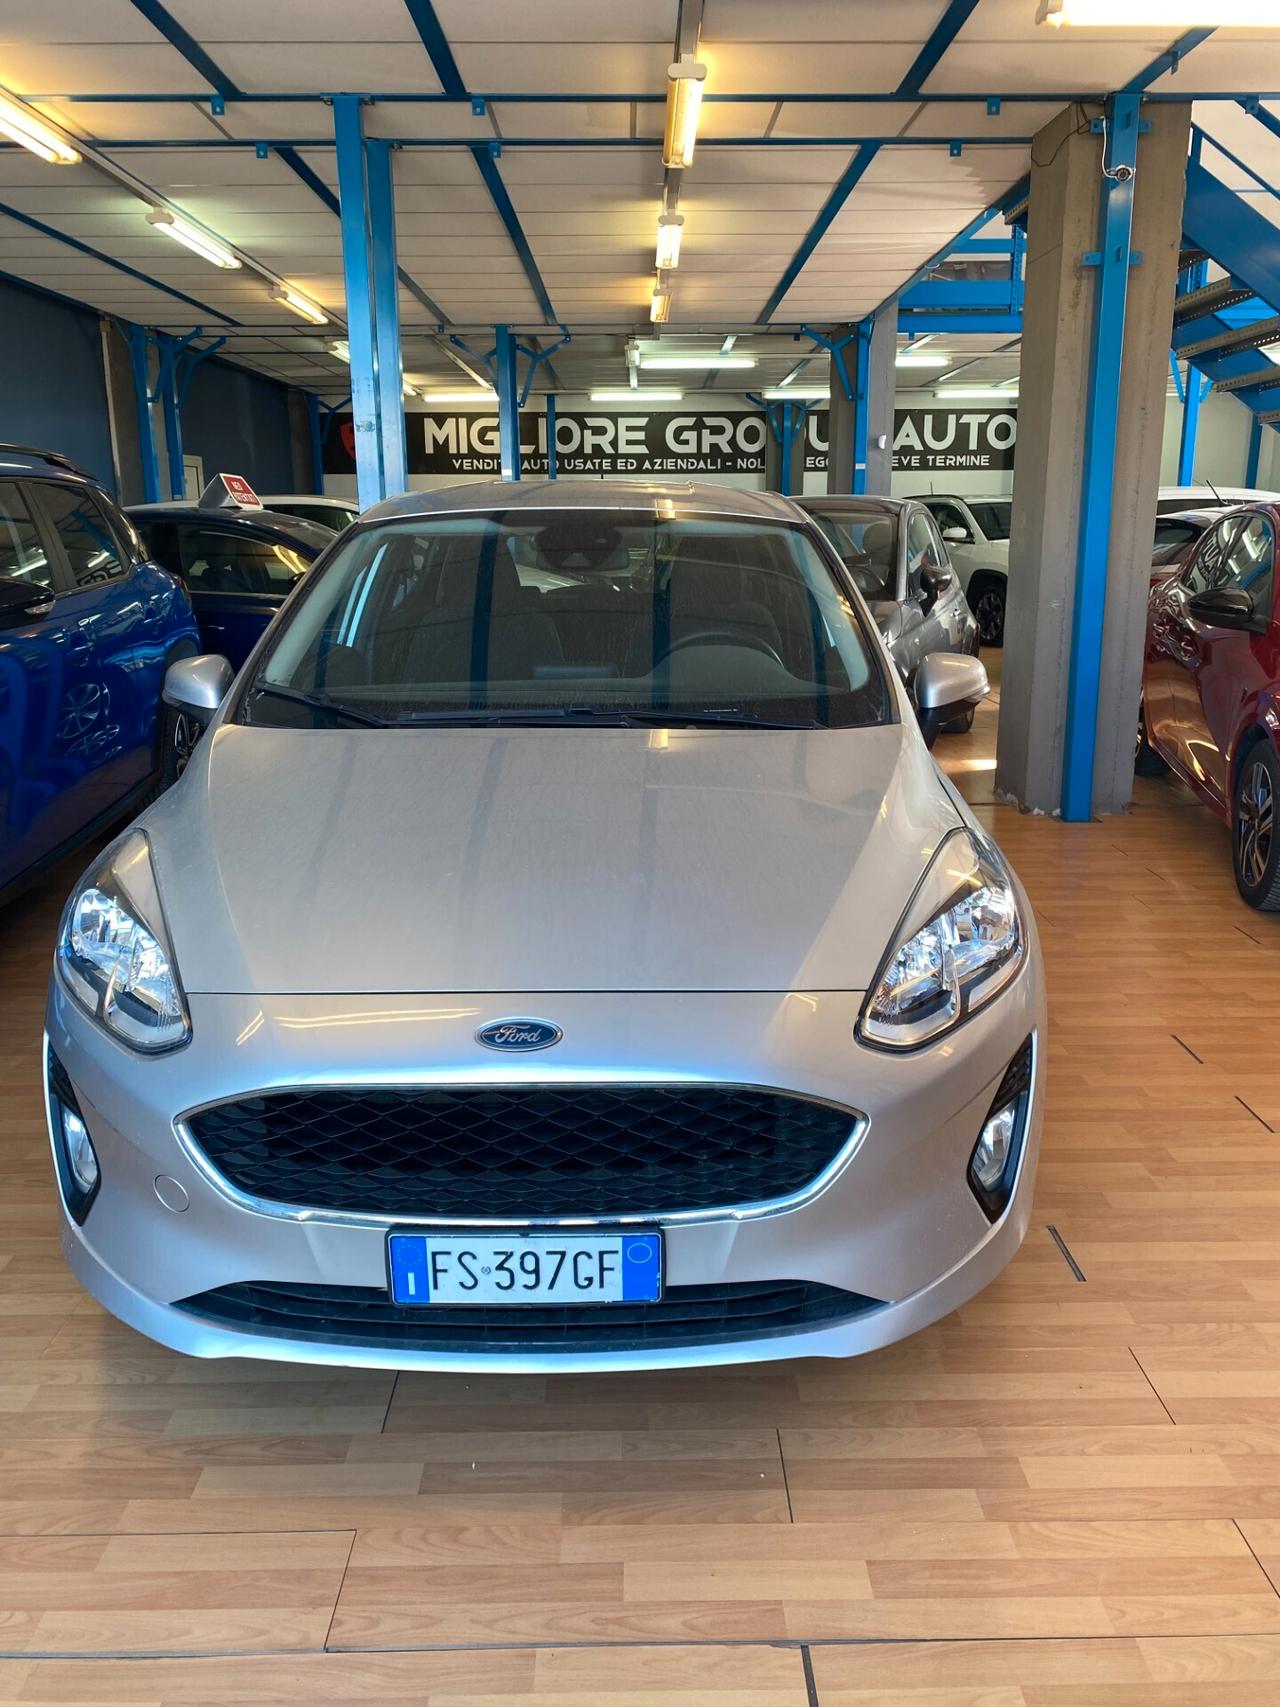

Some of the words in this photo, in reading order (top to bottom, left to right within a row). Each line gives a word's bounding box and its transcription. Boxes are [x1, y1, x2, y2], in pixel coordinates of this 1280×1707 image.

[424, 417, 650, 454] MIGIORE
[893, 413, 1017, 451] AUTO
[452, 459, 502, 470] VENDI
[522, 459, 559, 470] AUT
[564, 459, 611, 470] USATE
[617, 459, 637, 470] ED
[642, 458, 721, 470] AZIENDALI
[892, 455, 921, 467] EVE
[927, 455, 990, 467] TERMINE
[485, 1025, 542, 1043] Ford
